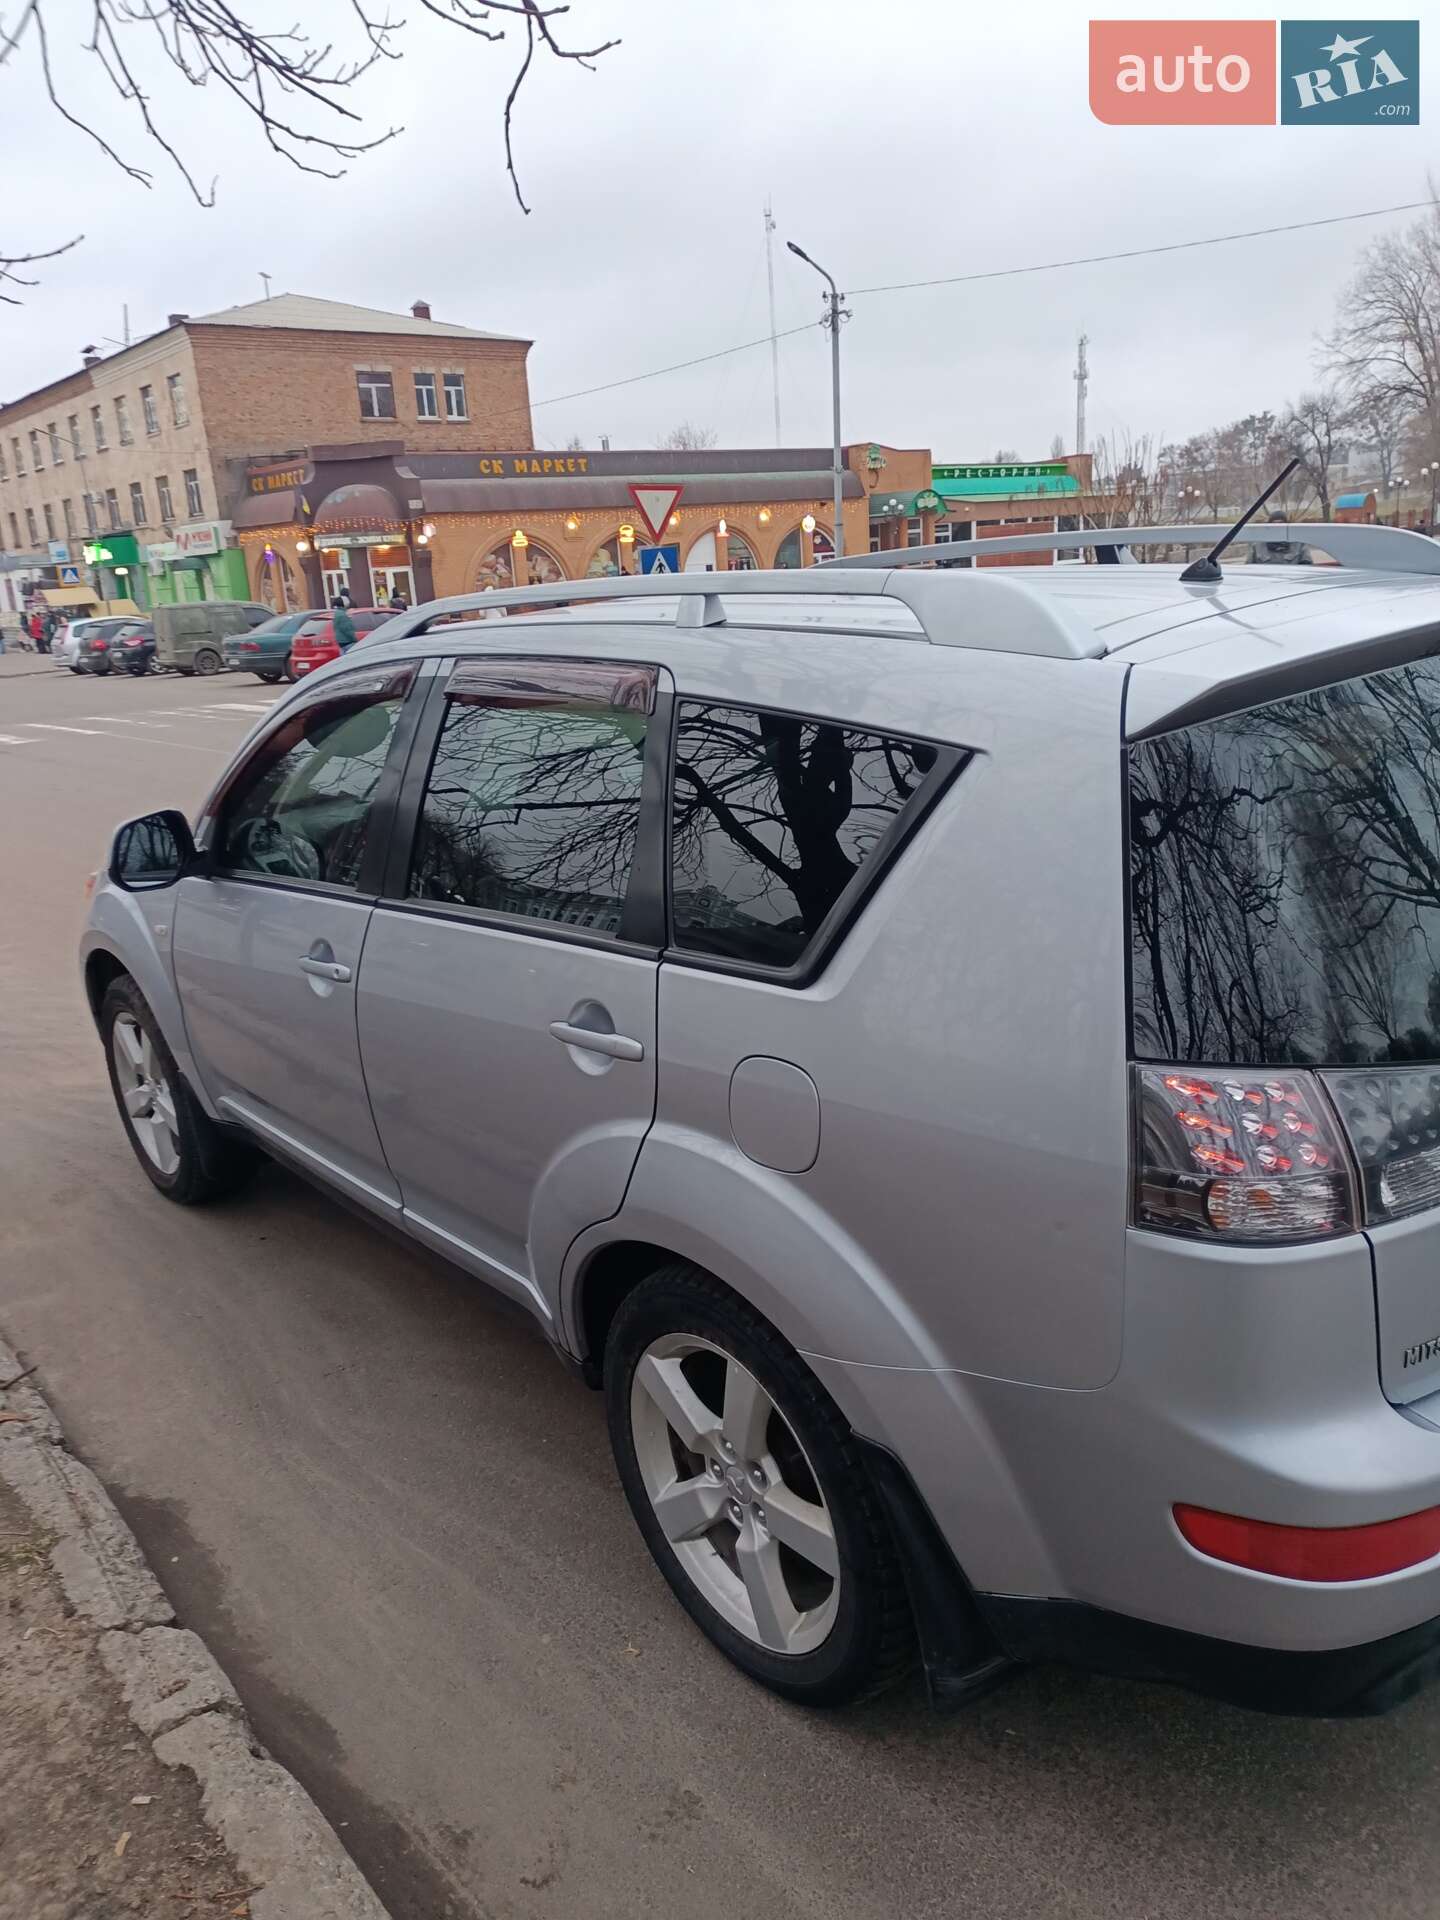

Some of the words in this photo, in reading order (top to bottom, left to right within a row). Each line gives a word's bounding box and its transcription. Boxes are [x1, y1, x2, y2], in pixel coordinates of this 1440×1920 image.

[479, 459, 504, 474] СК
[513, 458, 588, 473] МАРКЕТ
[953, 468, 1041, 478] РЕСТОРАН
